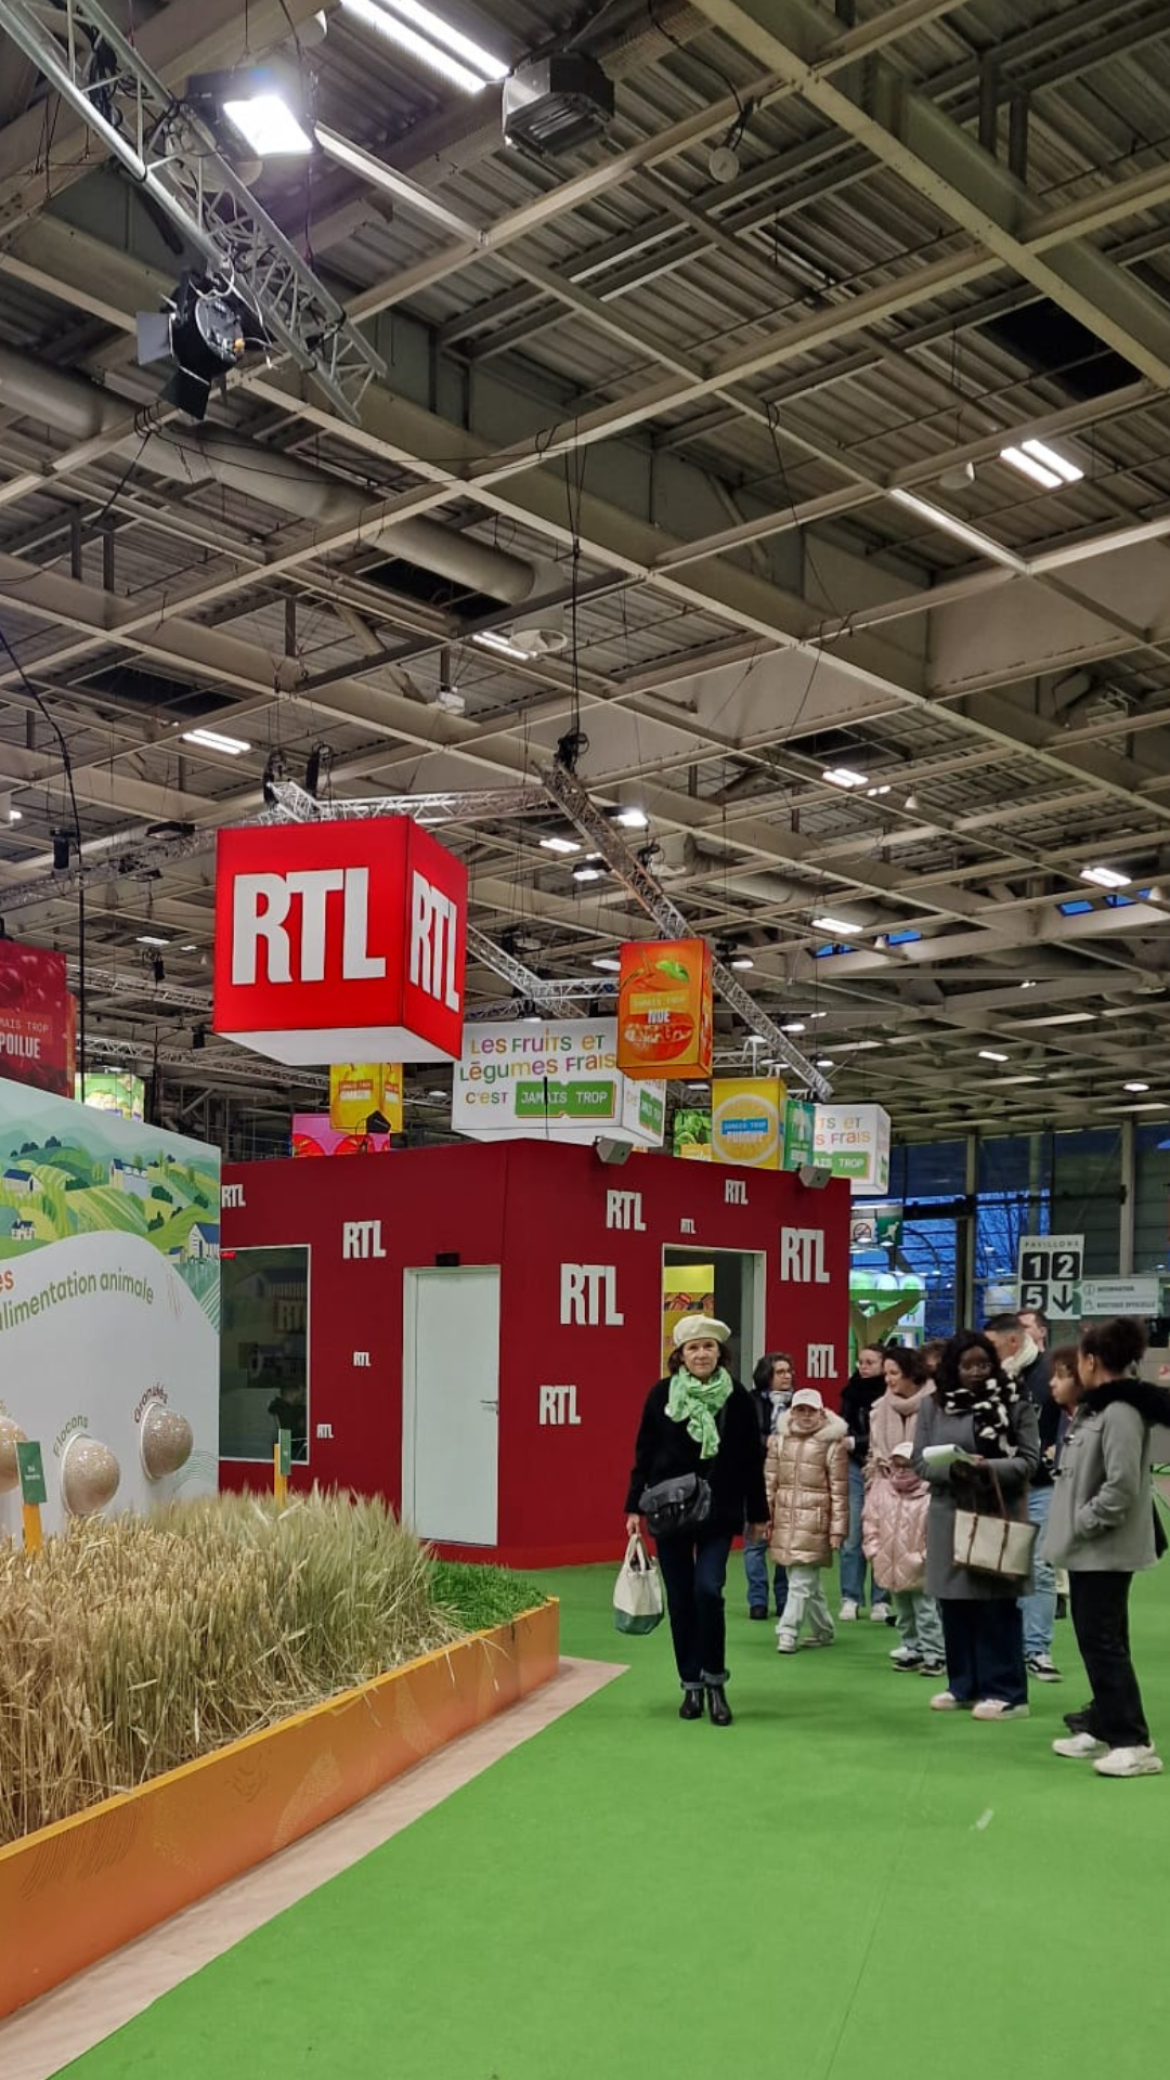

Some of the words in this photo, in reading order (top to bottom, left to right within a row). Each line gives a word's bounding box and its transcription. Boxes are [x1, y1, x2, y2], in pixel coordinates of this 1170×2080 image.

[232, 867, 386, 985] RTL
[409, 870, 460, 1014] RTL
[27, 1021, 49, 1034] TROP
[0, 1031, 41, 1060] POILUE
[577, 1091, 608, 1104] TROP
[838, 1157, 864, 1169] TROP
[222, 1184, 246, 1208] RTL
[724, 1179, 748, 1204] RTL
[605, 1189, 646, 1231] RTL
[342, 1220, 386, 1259] RTL
[680, 1218, 696, 1234] RTL
[780, 1226, 830, 1283] RTL
[1029, 1255, 1042, 1279] 1
[1057, 1254, 1074, 1278] 2
[100, 1267, 153, 1304] animale
[560, 1263, 624, 1325] RTL
[1025, 1286, 1043, 1309] 5
[353, 1352, 370, 1367] RTL
[807, 1344, 838, 1378] RTL
[539, 1386, 581, 1425] RTL
[53, 1415, 89, 1457] Flocons
[316, 1424, 333, 1438] RTL
